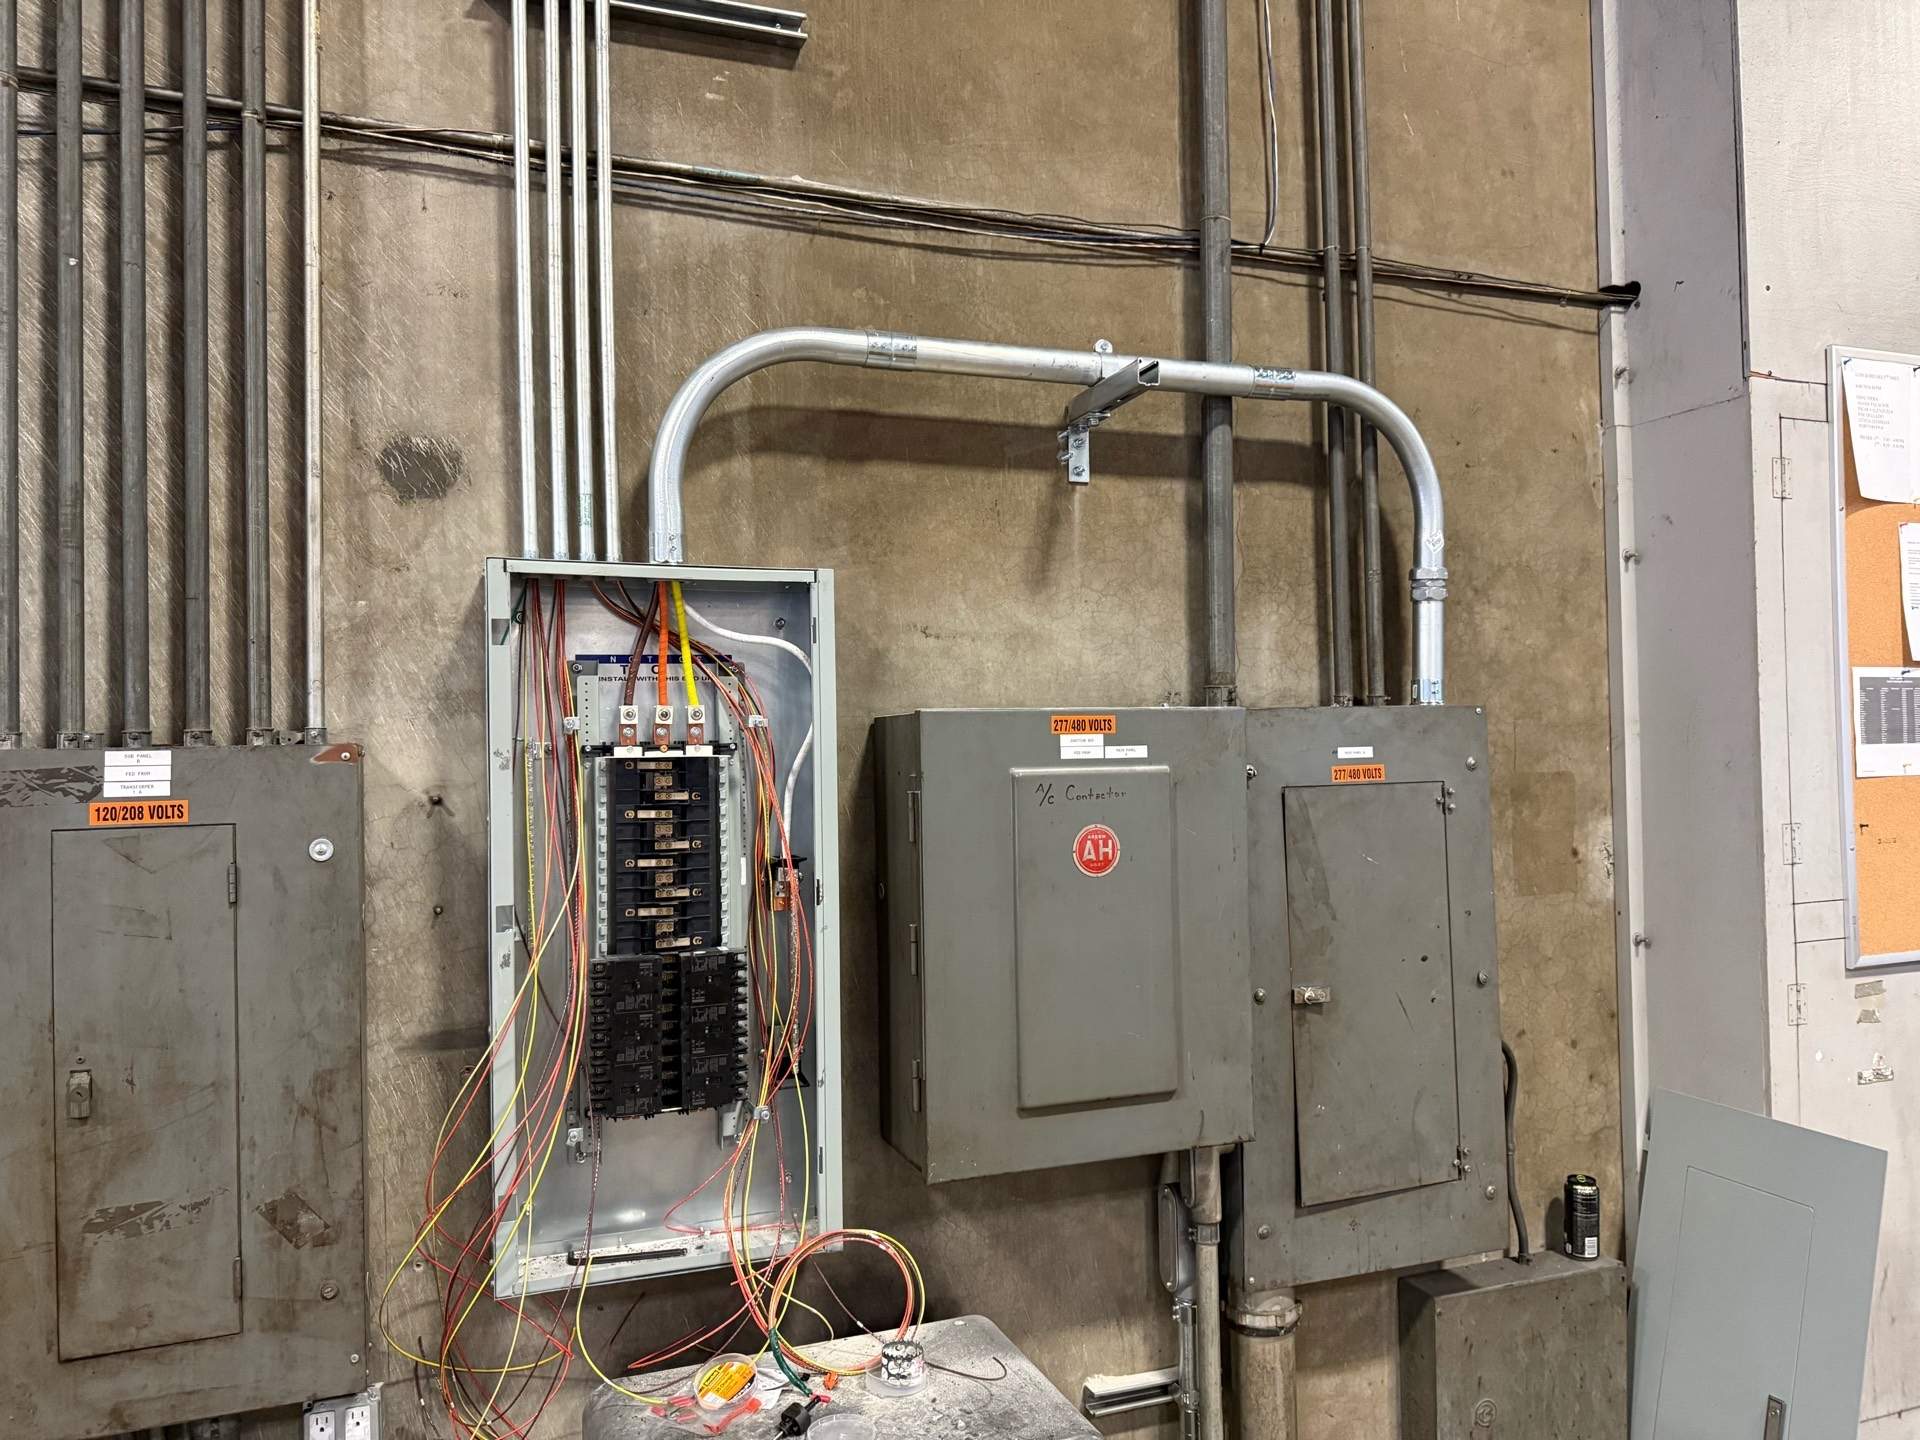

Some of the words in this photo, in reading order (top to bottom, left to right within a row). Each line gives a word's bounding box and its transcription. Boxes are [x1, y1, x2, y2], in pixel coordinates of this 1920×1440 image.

[1053, 718, 1086, 732] 277/480
[1088, 718, 1112, 732] VOLTS
[1362, 767, 1382, 779] VOLTS
[95, 806, 144, 822] 120/208
[148, 804, 184, 820] VOLTS
[1082, 839, 1113, 862] AH
